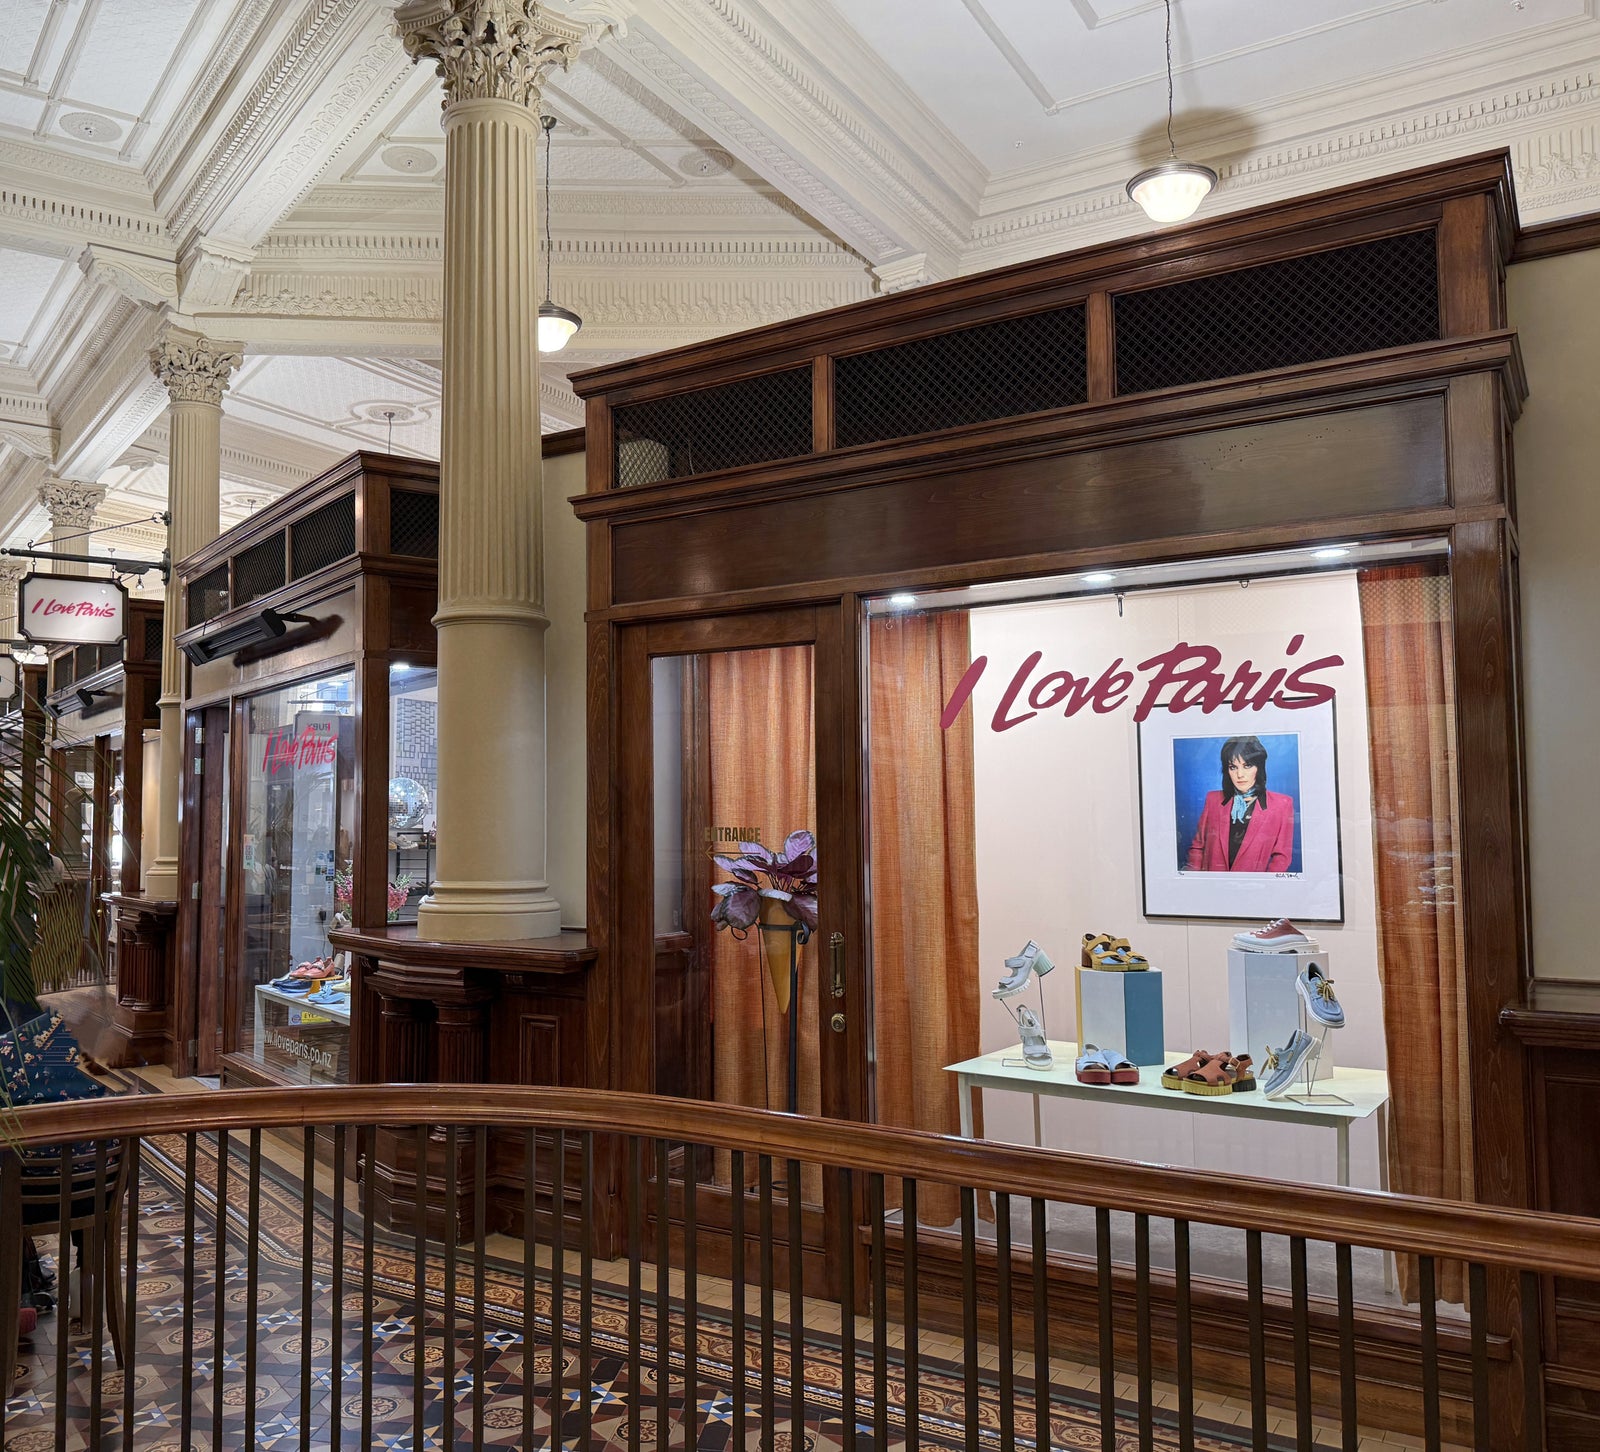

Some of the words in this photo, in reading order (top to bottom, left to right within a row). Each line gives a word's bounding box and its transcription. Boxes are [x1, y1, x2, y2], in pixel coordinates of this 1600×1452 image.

[31, 598, 44, 614] I
[43, 599, 76, 616] Love
[75, 601, 116, 618] Paris
[938, 655, 988, 729] I
[990, 650, 1134, 733] Love
[1132, 634, 1345, 723] Paris
